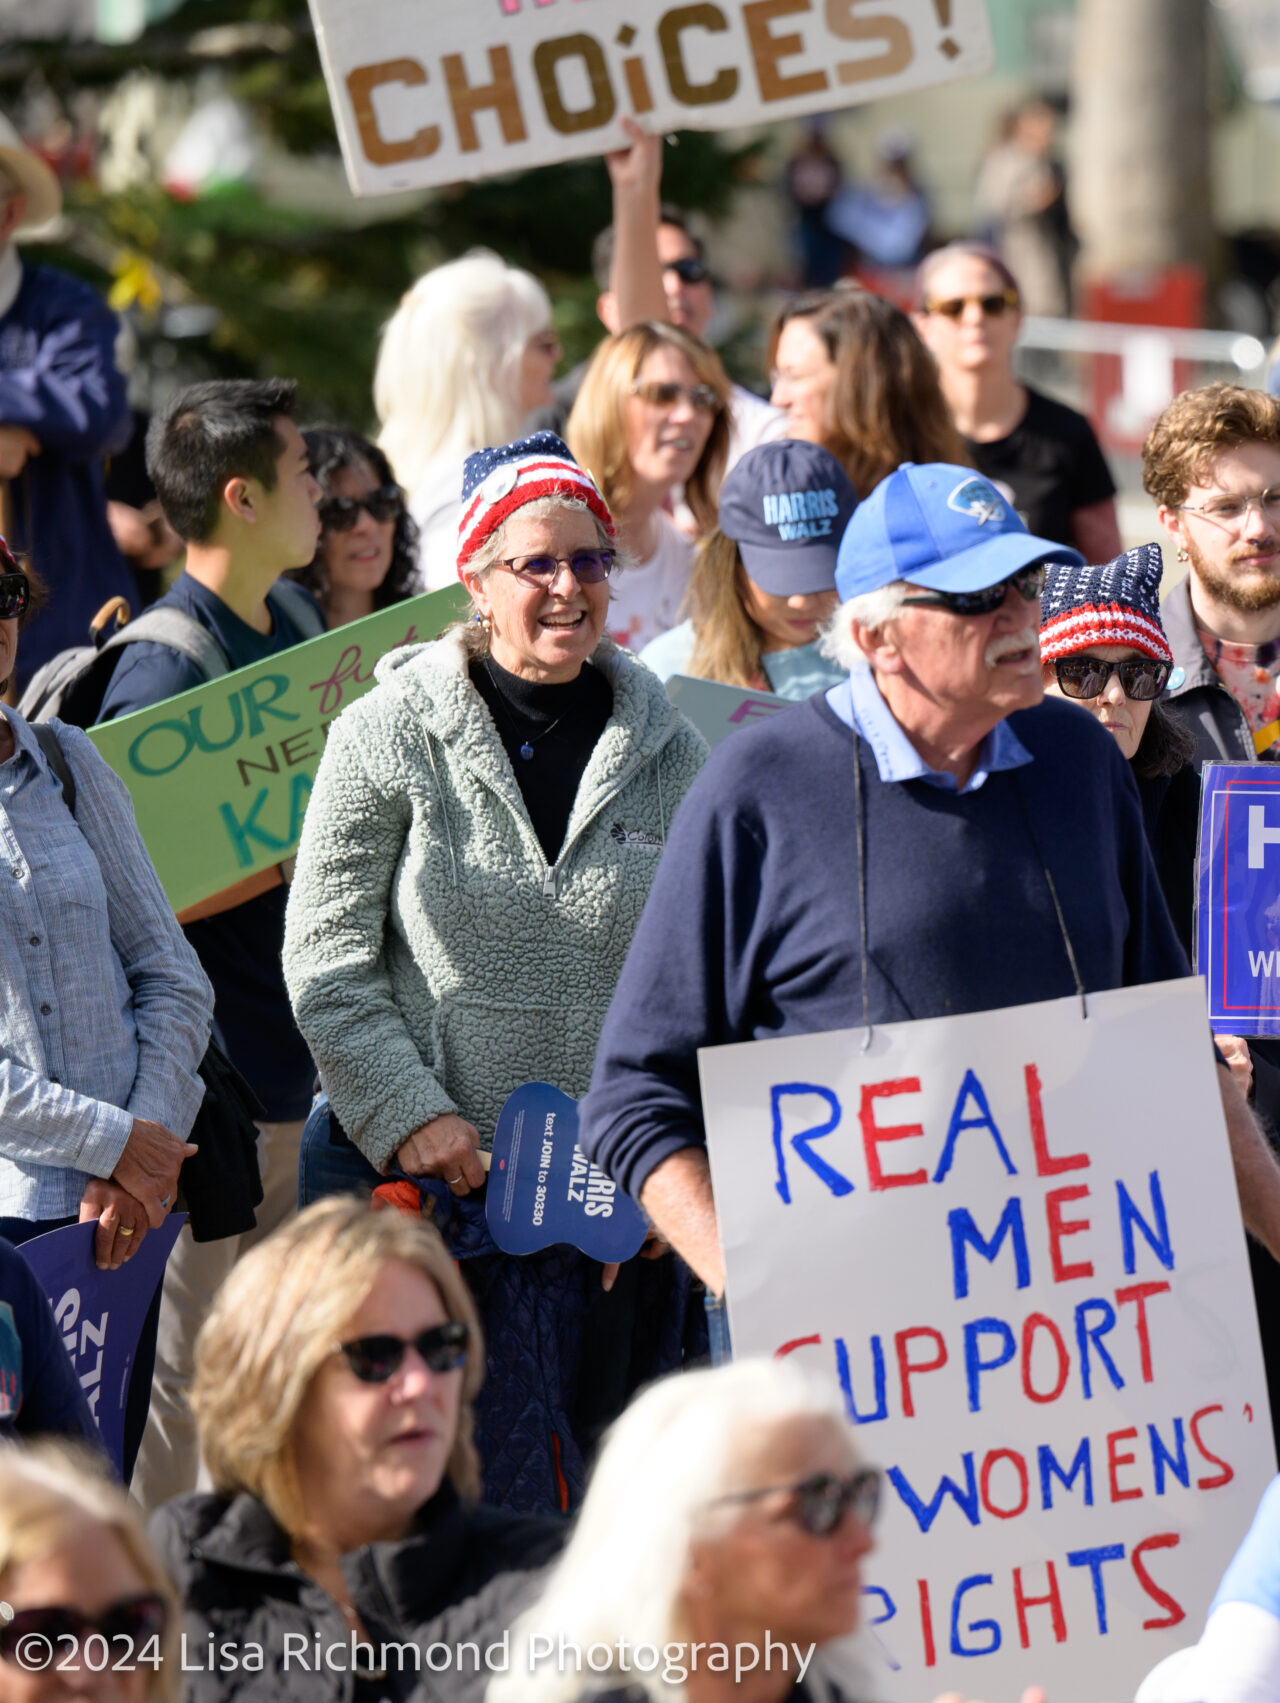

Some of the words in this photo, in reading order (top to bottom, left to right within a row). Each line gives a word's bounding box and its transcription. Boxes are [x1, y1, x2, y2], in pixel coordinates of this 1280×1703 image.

[763, 489, 840, 525] HARRIS
[778, 519, 833, 541] WALZ
[128, 673, 301, 777] OUR
[236, 722, 331, 788] NE
[543, 1111, 557, 1137] text
[770, 1062, 1091, 1205] REAL
[537, 1168, 549, 1184] to
[540, 1138, 554, 1169] JOIN
[532, 1185, 548, 1227] 30330
[947, 1169, 1175, 1300] MEN
[774, 1281, 1172, 1426] UPPORT
[886, 1402, 1254, 1534] WOMENS'
